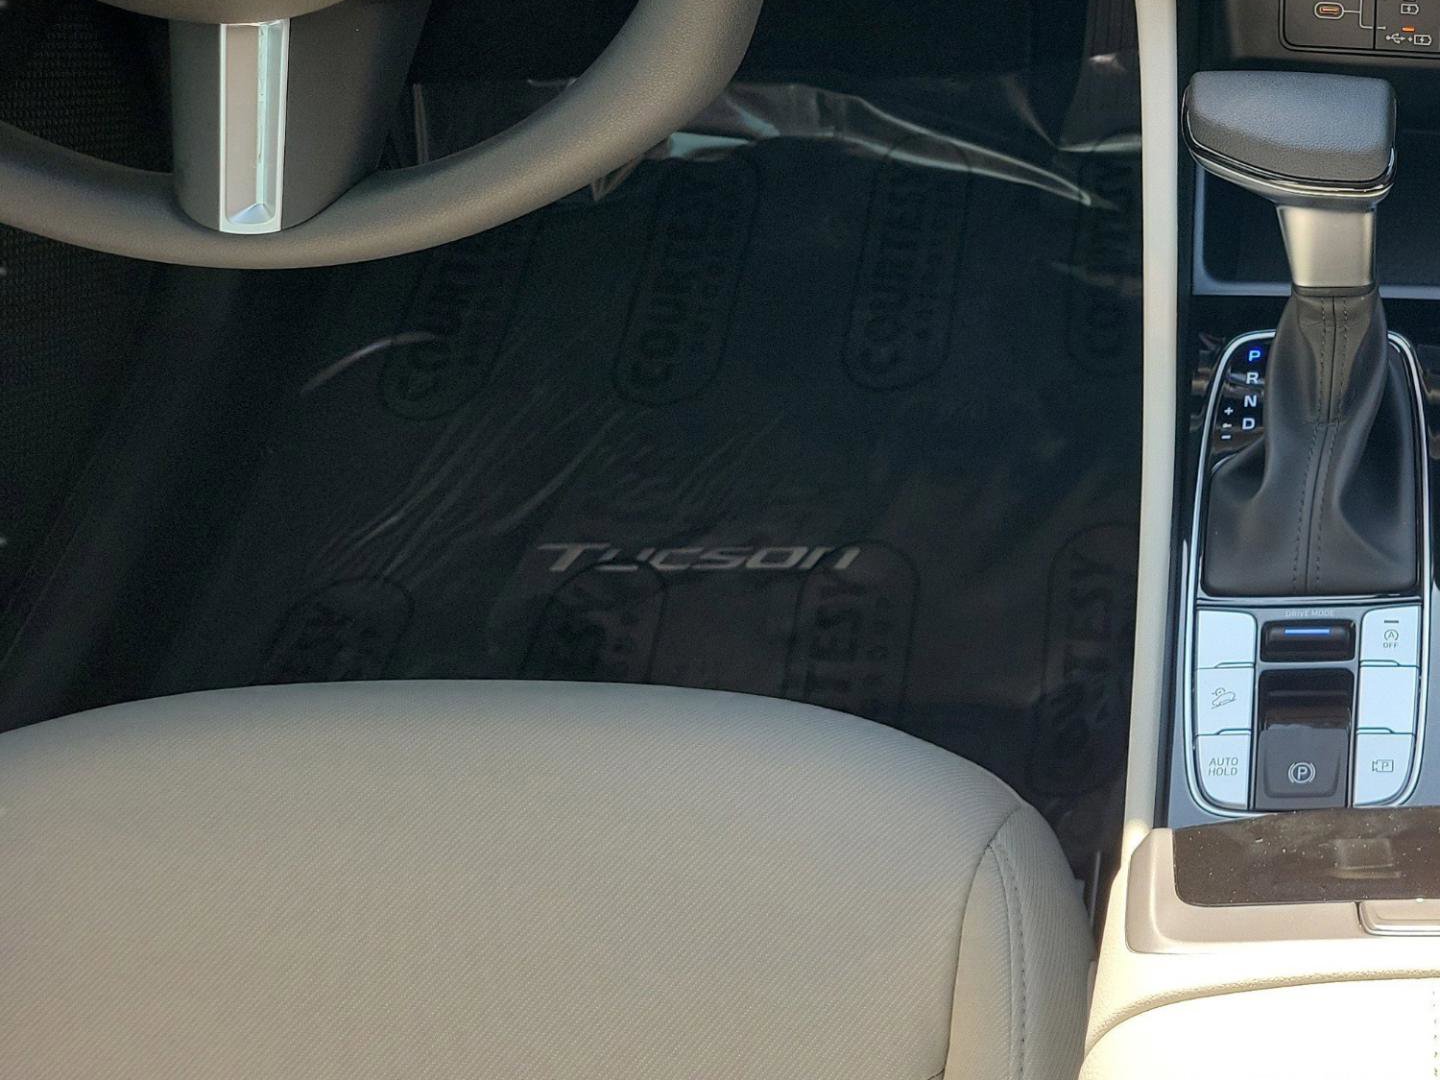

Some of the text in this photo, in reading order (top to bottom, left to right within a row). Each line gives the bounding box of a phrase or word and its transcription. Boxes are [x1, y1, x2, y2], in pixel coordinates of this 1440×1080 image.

[1248, 350, 1261, 362] P
[1246, 371, 1259, 384] R
[1243, 395, 1257, 407] N
[1242, 418, 1255, 430] D
[1285, 609, 1336, 617] DRIVE MODE
[1209, 757, 1239, 767] AUTO
[1208, 767, 1238, 777] HOLD
